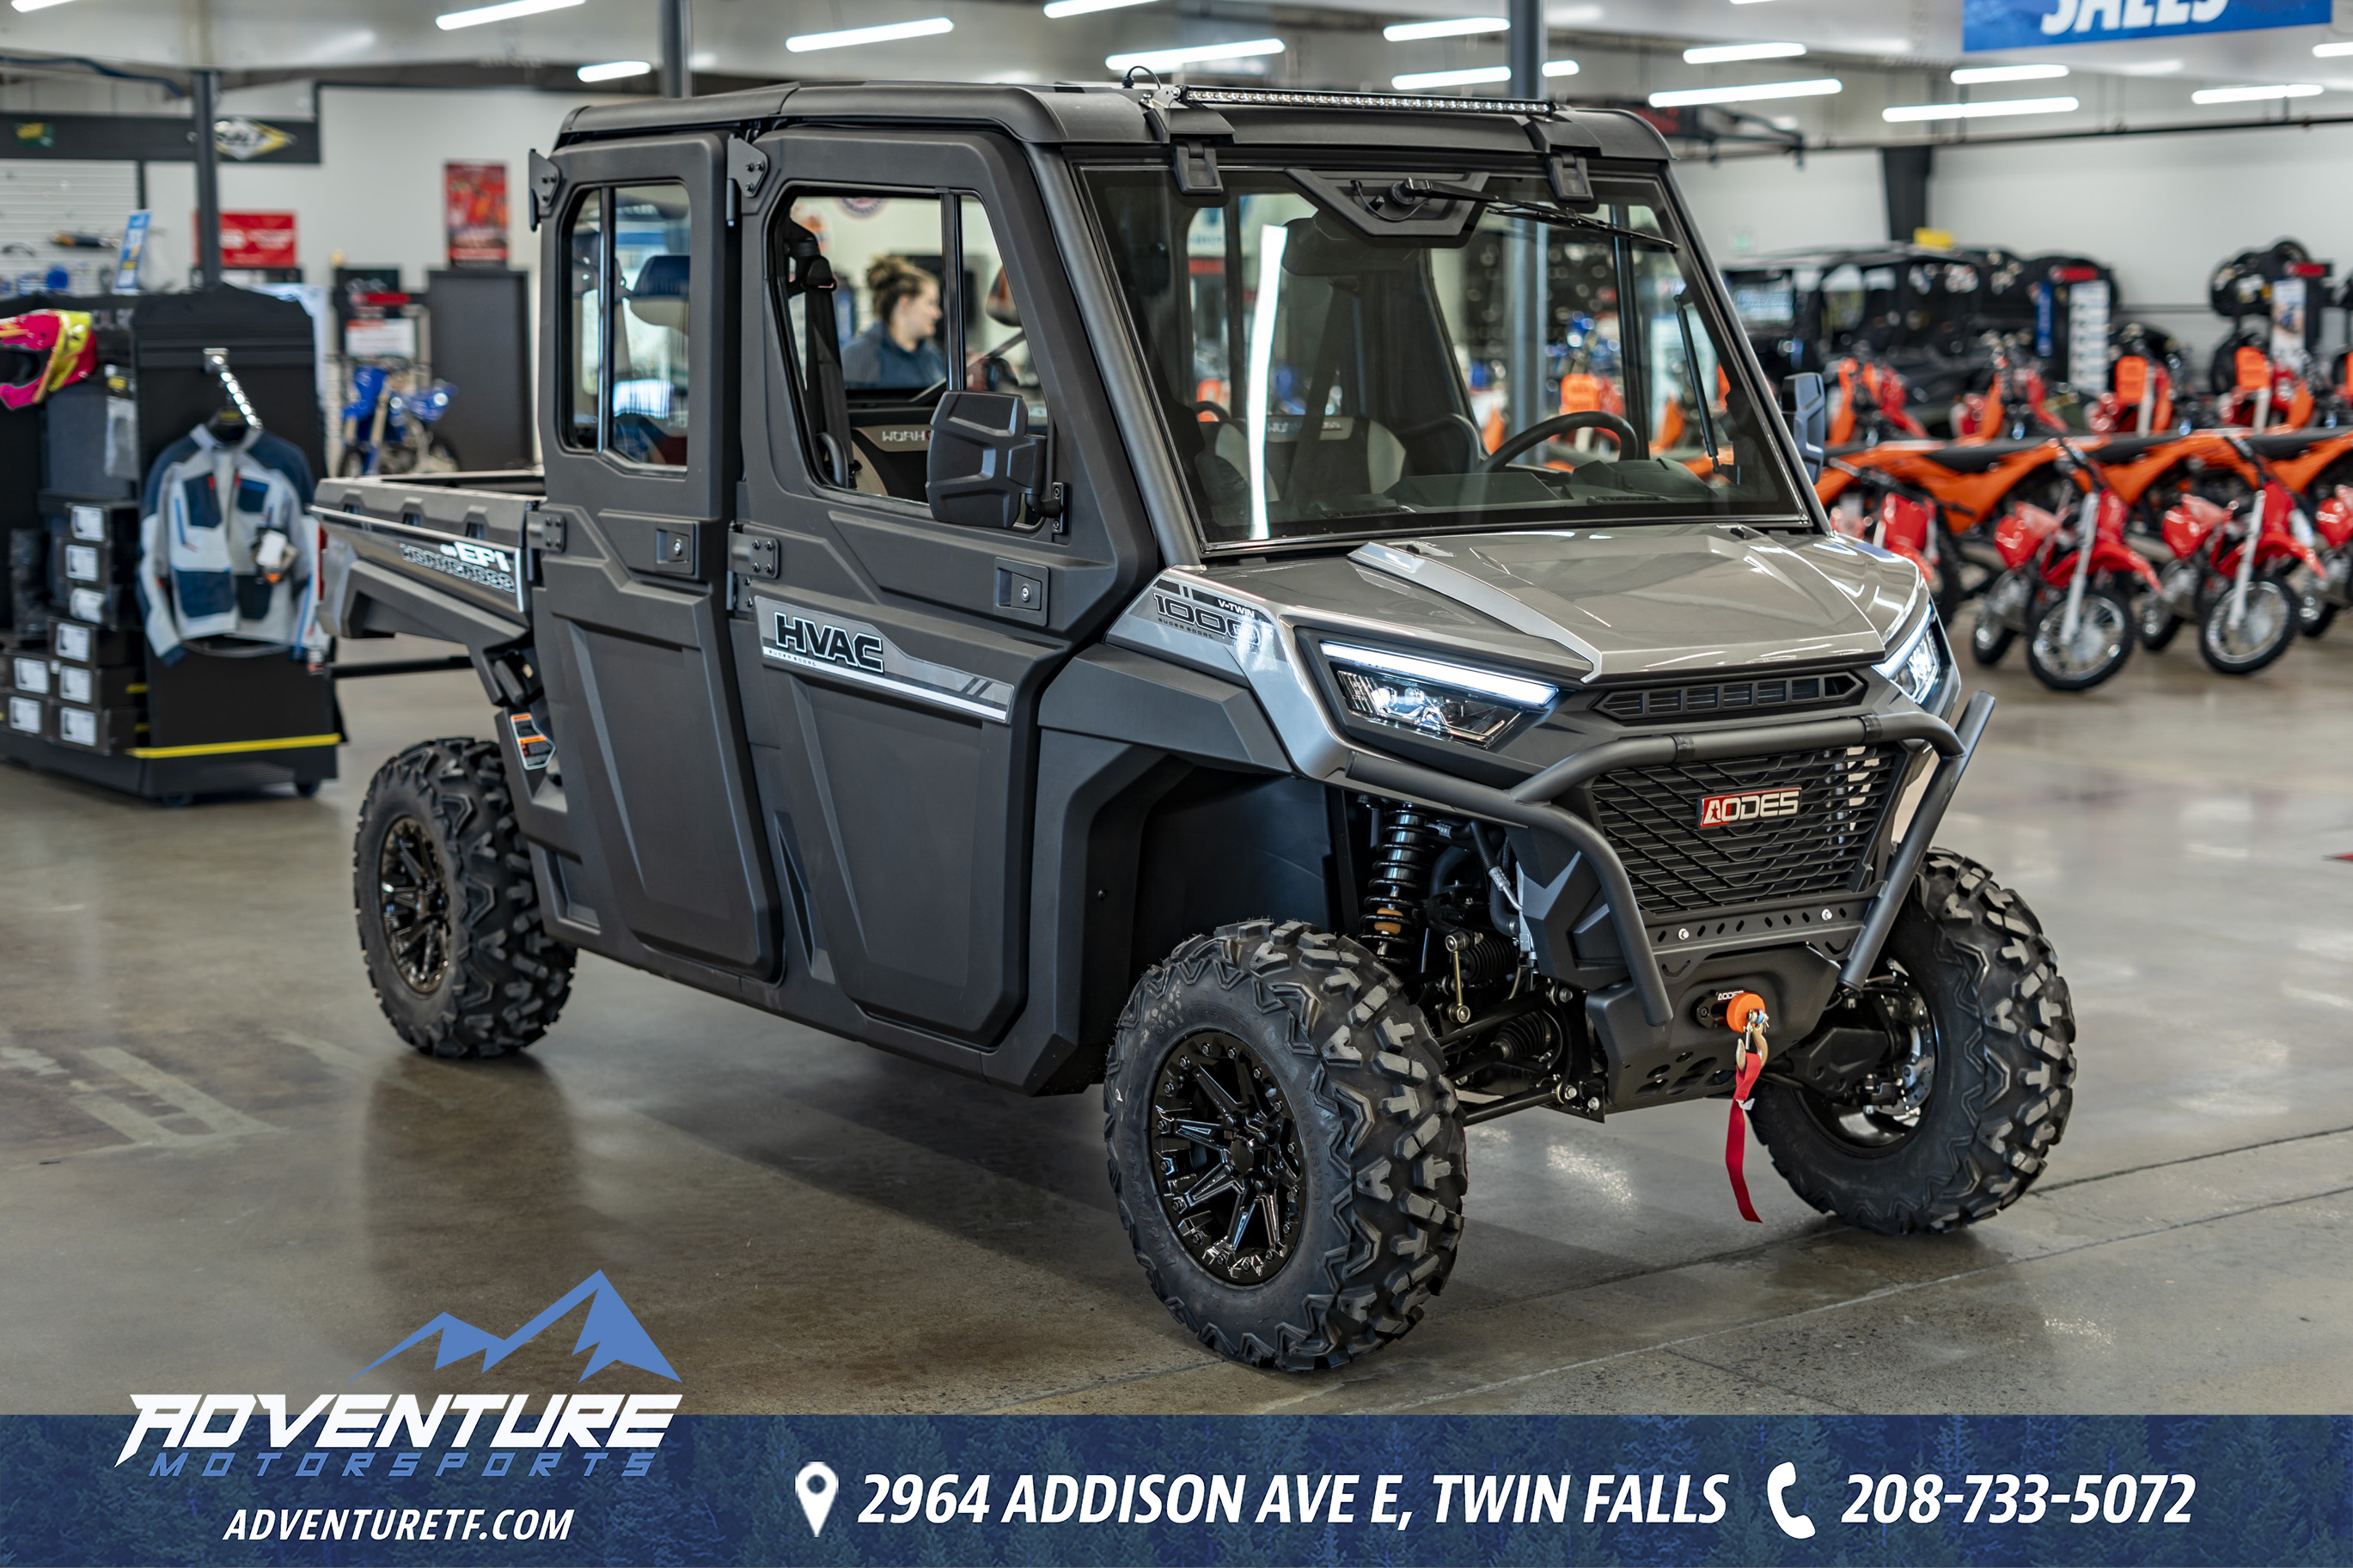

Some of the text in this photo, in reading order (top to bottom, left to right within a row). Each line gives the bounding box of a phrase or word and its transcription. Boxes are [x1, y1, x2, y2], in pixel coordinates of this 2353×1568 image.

[1218, 599, 1256, 618] V-TWIN
[774, 611, 885, 675] HVAC
[1702, 790, 1800, 825] AODES
